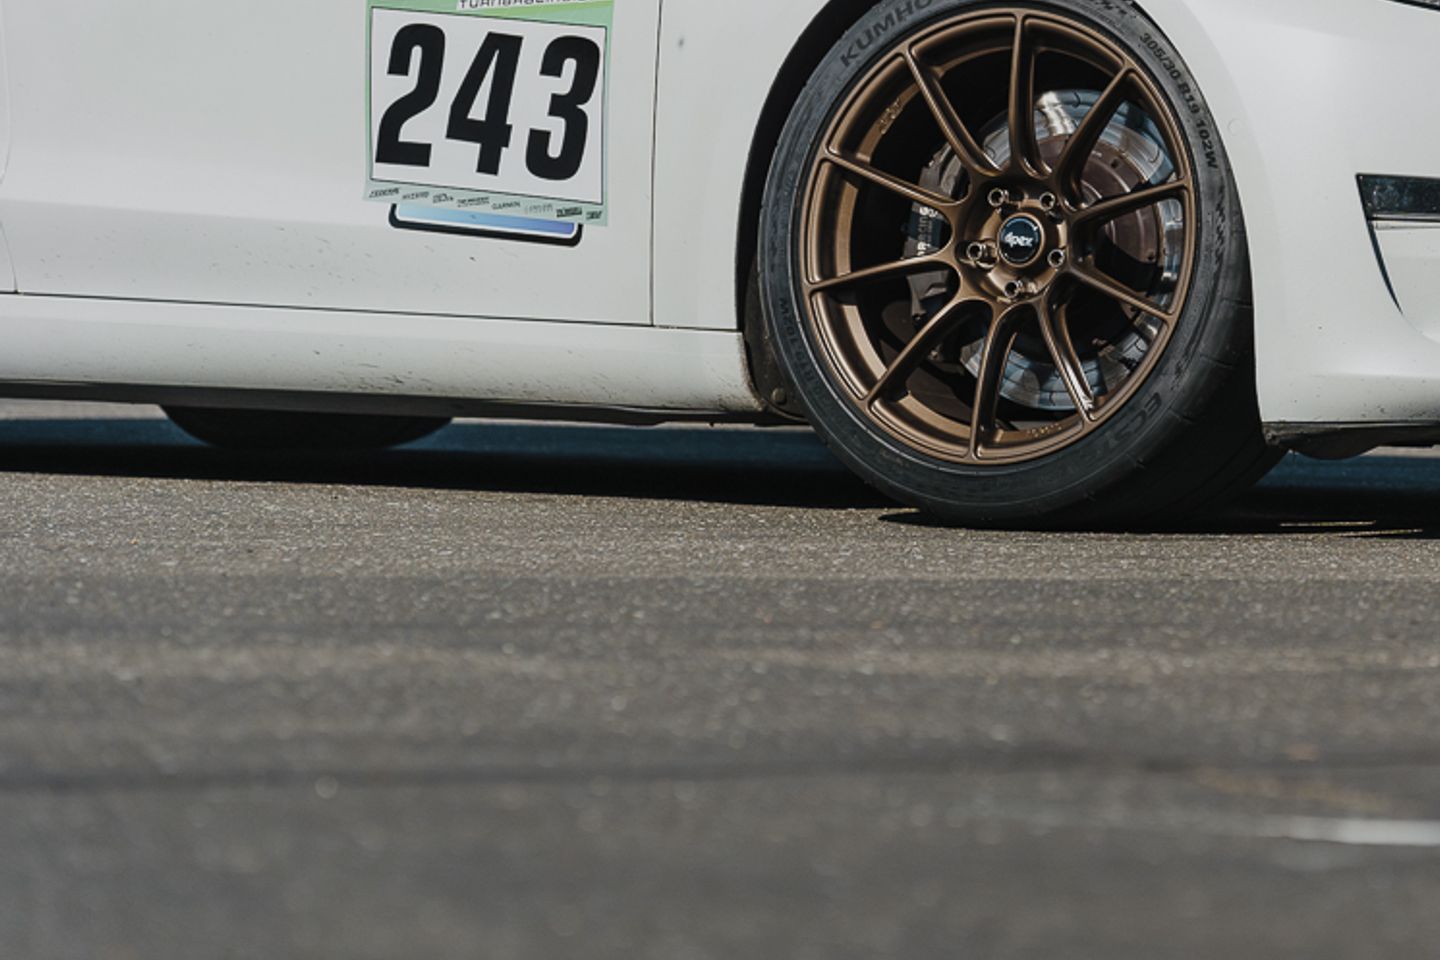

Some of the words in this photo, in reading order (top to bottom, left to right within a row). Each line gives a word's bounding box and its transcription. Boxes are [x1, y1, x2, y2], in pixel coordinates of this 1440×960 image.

[375, 23, 601, 180] 243
[1140, 32, 1181, 80] 305/30
[1177, 80, 1200, 115] R19
[1196, 120, 1218, 169] 102W
